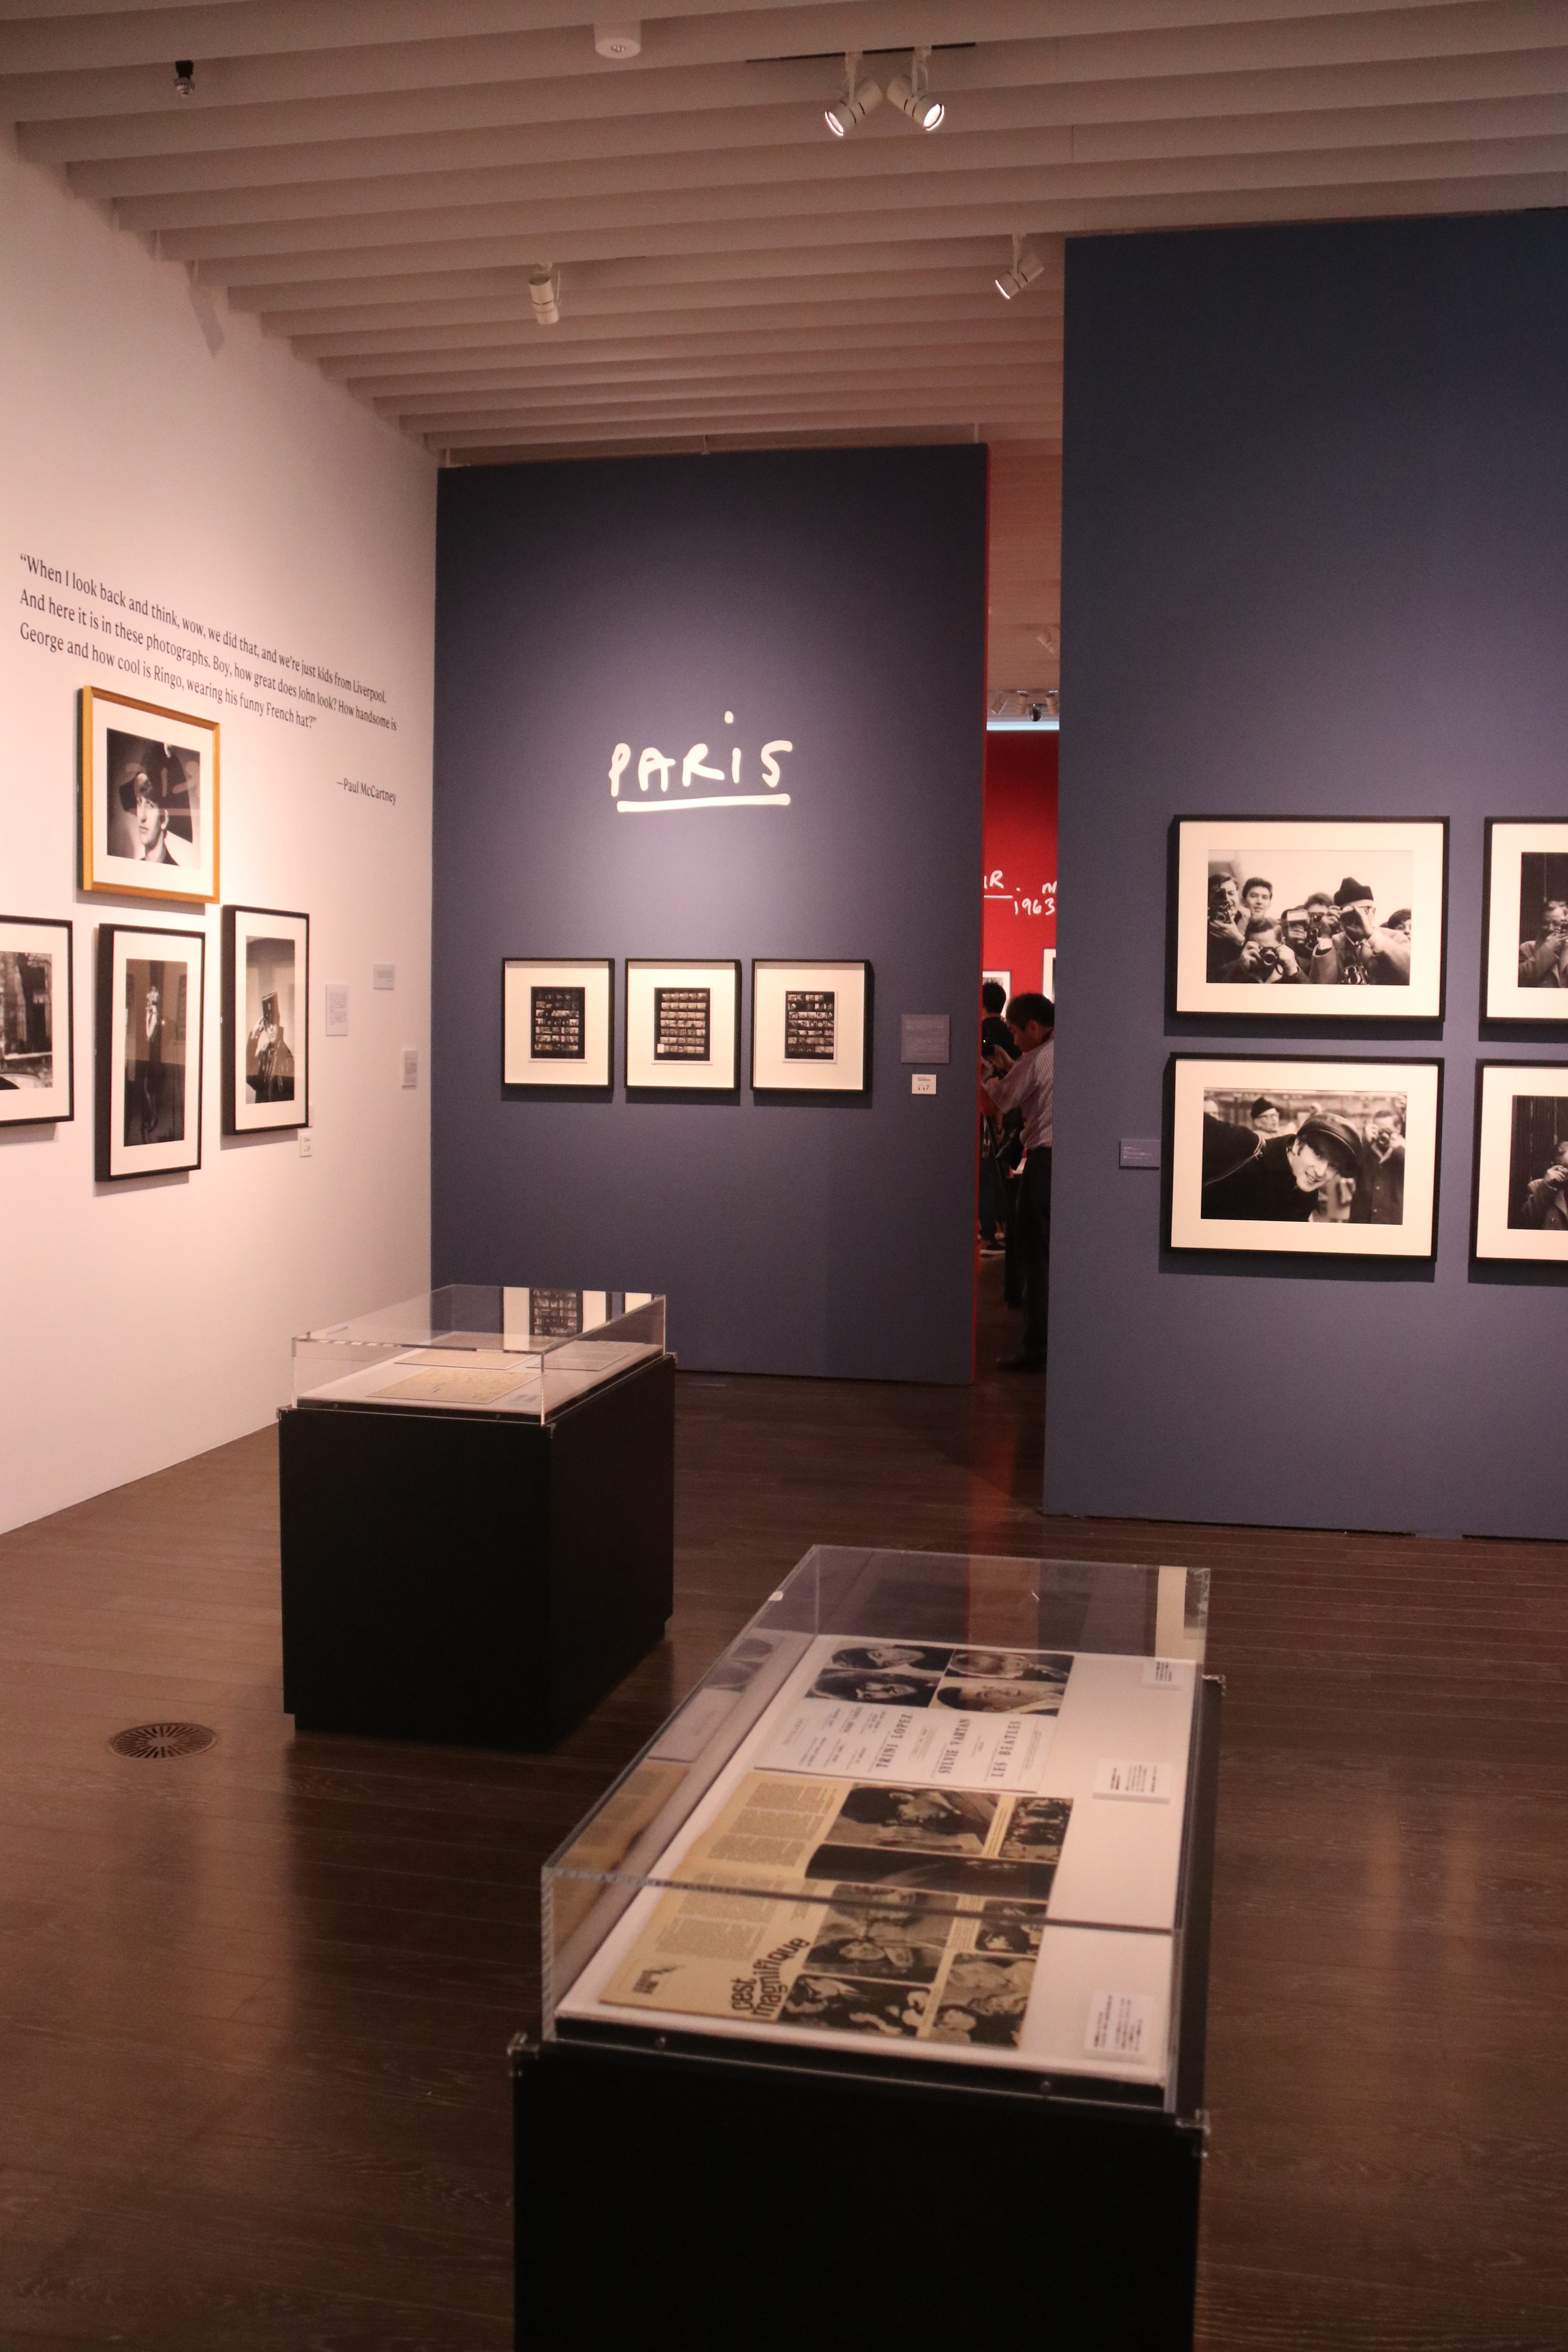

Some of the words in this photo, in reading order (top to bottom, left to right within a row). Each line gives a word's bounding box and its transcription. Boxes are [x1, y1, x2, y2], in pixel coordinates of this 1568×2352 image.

[66, 570, 69, 586] I
[73, 572, 97, 597] look
[100, 583, 126, 607] back
[129, 599, 148, 615] and
[151, 604, 180, 629] think,
[182, 618, 205, 638] wow,
[208, 628, 220, 642] we
[223, 631, 237, 648] did
[240, 638, 259, 658] that,
[262, 649, 277, 663] and
[302, 660, 316, 677] just
[318, 666, 333, 683] kids
[335, 672, 351, 691] from
[354, 680, 386, 703] Liverpool.
[20, 589, 45, 612] And
[49, 597, 74, 621] here
[78, 607, 87, 625] it
[90, 611, 98, 629] is
[102, 615, 111, 634] in
[115, 622, 143, 644] these
[147, 634, 210, 668] photographs.
[213, 656, 232, 677] Boy,
[235, 663, 252, 681] how
[254, 674, 276, 690] great
[278, 679, 296, 697] does
[299, 686, 315, 703] John
[317, 692, 337, 710] look?
[339, 700, 354, 716] How
[356, 706, 390, 728] handsome
[391, 718, 396, 731] is
[20, 622, 64, 653] George
[67, 641, 89, 659] and
[92, 644, 114, 666] how
[118, 658, 140, 675] cool
[143, 661, 151, 678] is
[154, 665, 184, 690] Ringo,
[187, 679, 223, 704] wearing
[225, 688, 238, 705] his
[240, 693, 264, 716] funny
[267, 702, 294, 722] French
[361, 783, 396, 806] McCartney
[1014, 897, 1055, 915] 1963
[891, 1714, 913, 1739] LOPEZ
[998, 1721, 1022, 1756] BEATLES
[938, 1749, 959, 1774] SYLVIE
[949, 1719, 971, 1746] VARTAN
[991, 1762, 1007, 1777] LES
